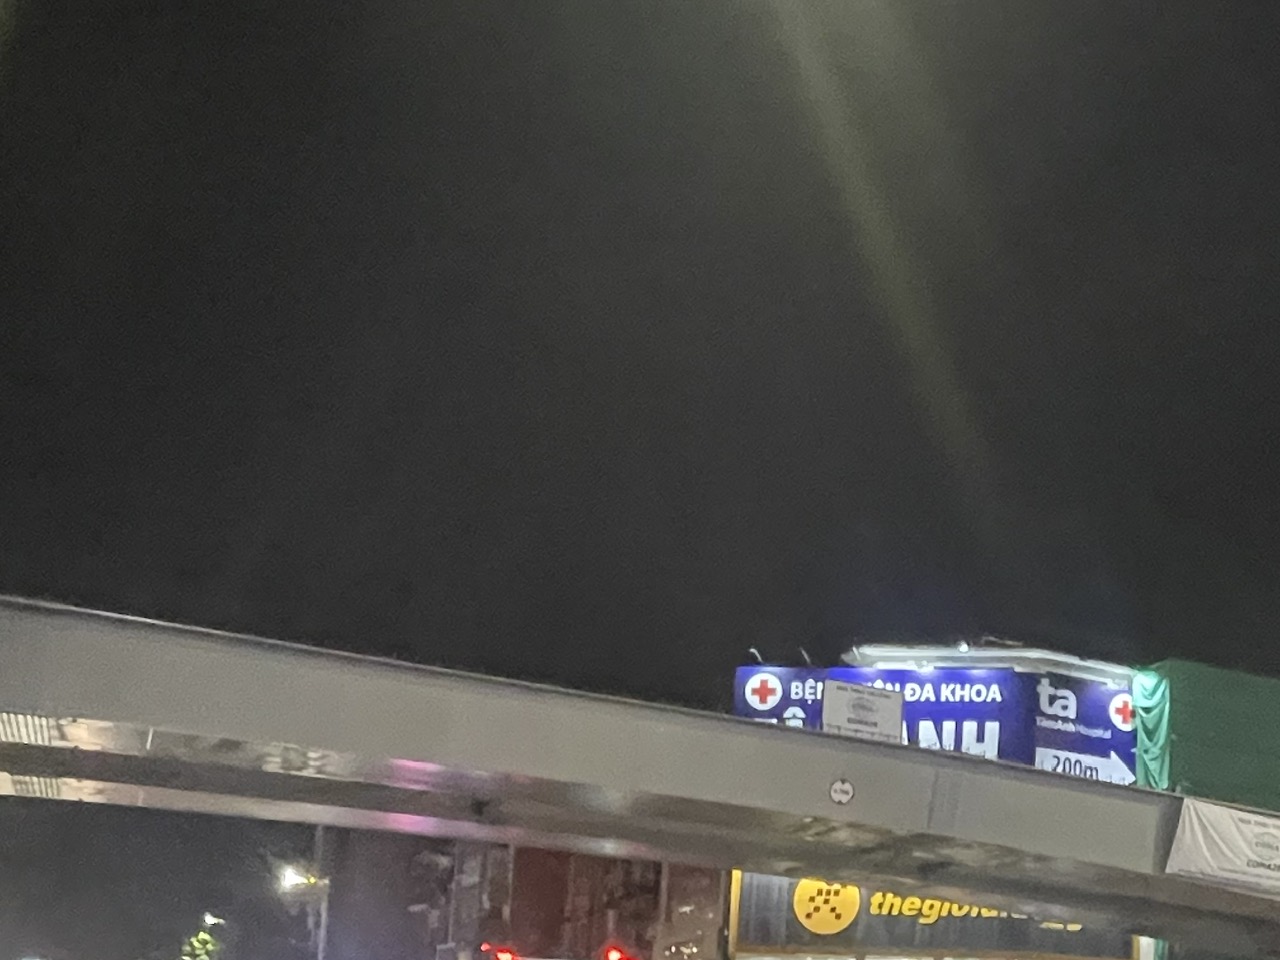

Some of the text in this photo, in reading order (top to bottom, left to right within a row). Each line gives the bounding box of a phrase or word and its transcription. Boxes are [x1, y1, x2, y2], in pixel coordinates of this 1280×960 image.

[790, 678, 824, 704] BỆ
[903, 682, 936, 702] ĐA
[940, 682, 1003, 703] KHOA
[1036, 677, 1077, 719] ta
[1052, 755, 1099, 780] 200m
